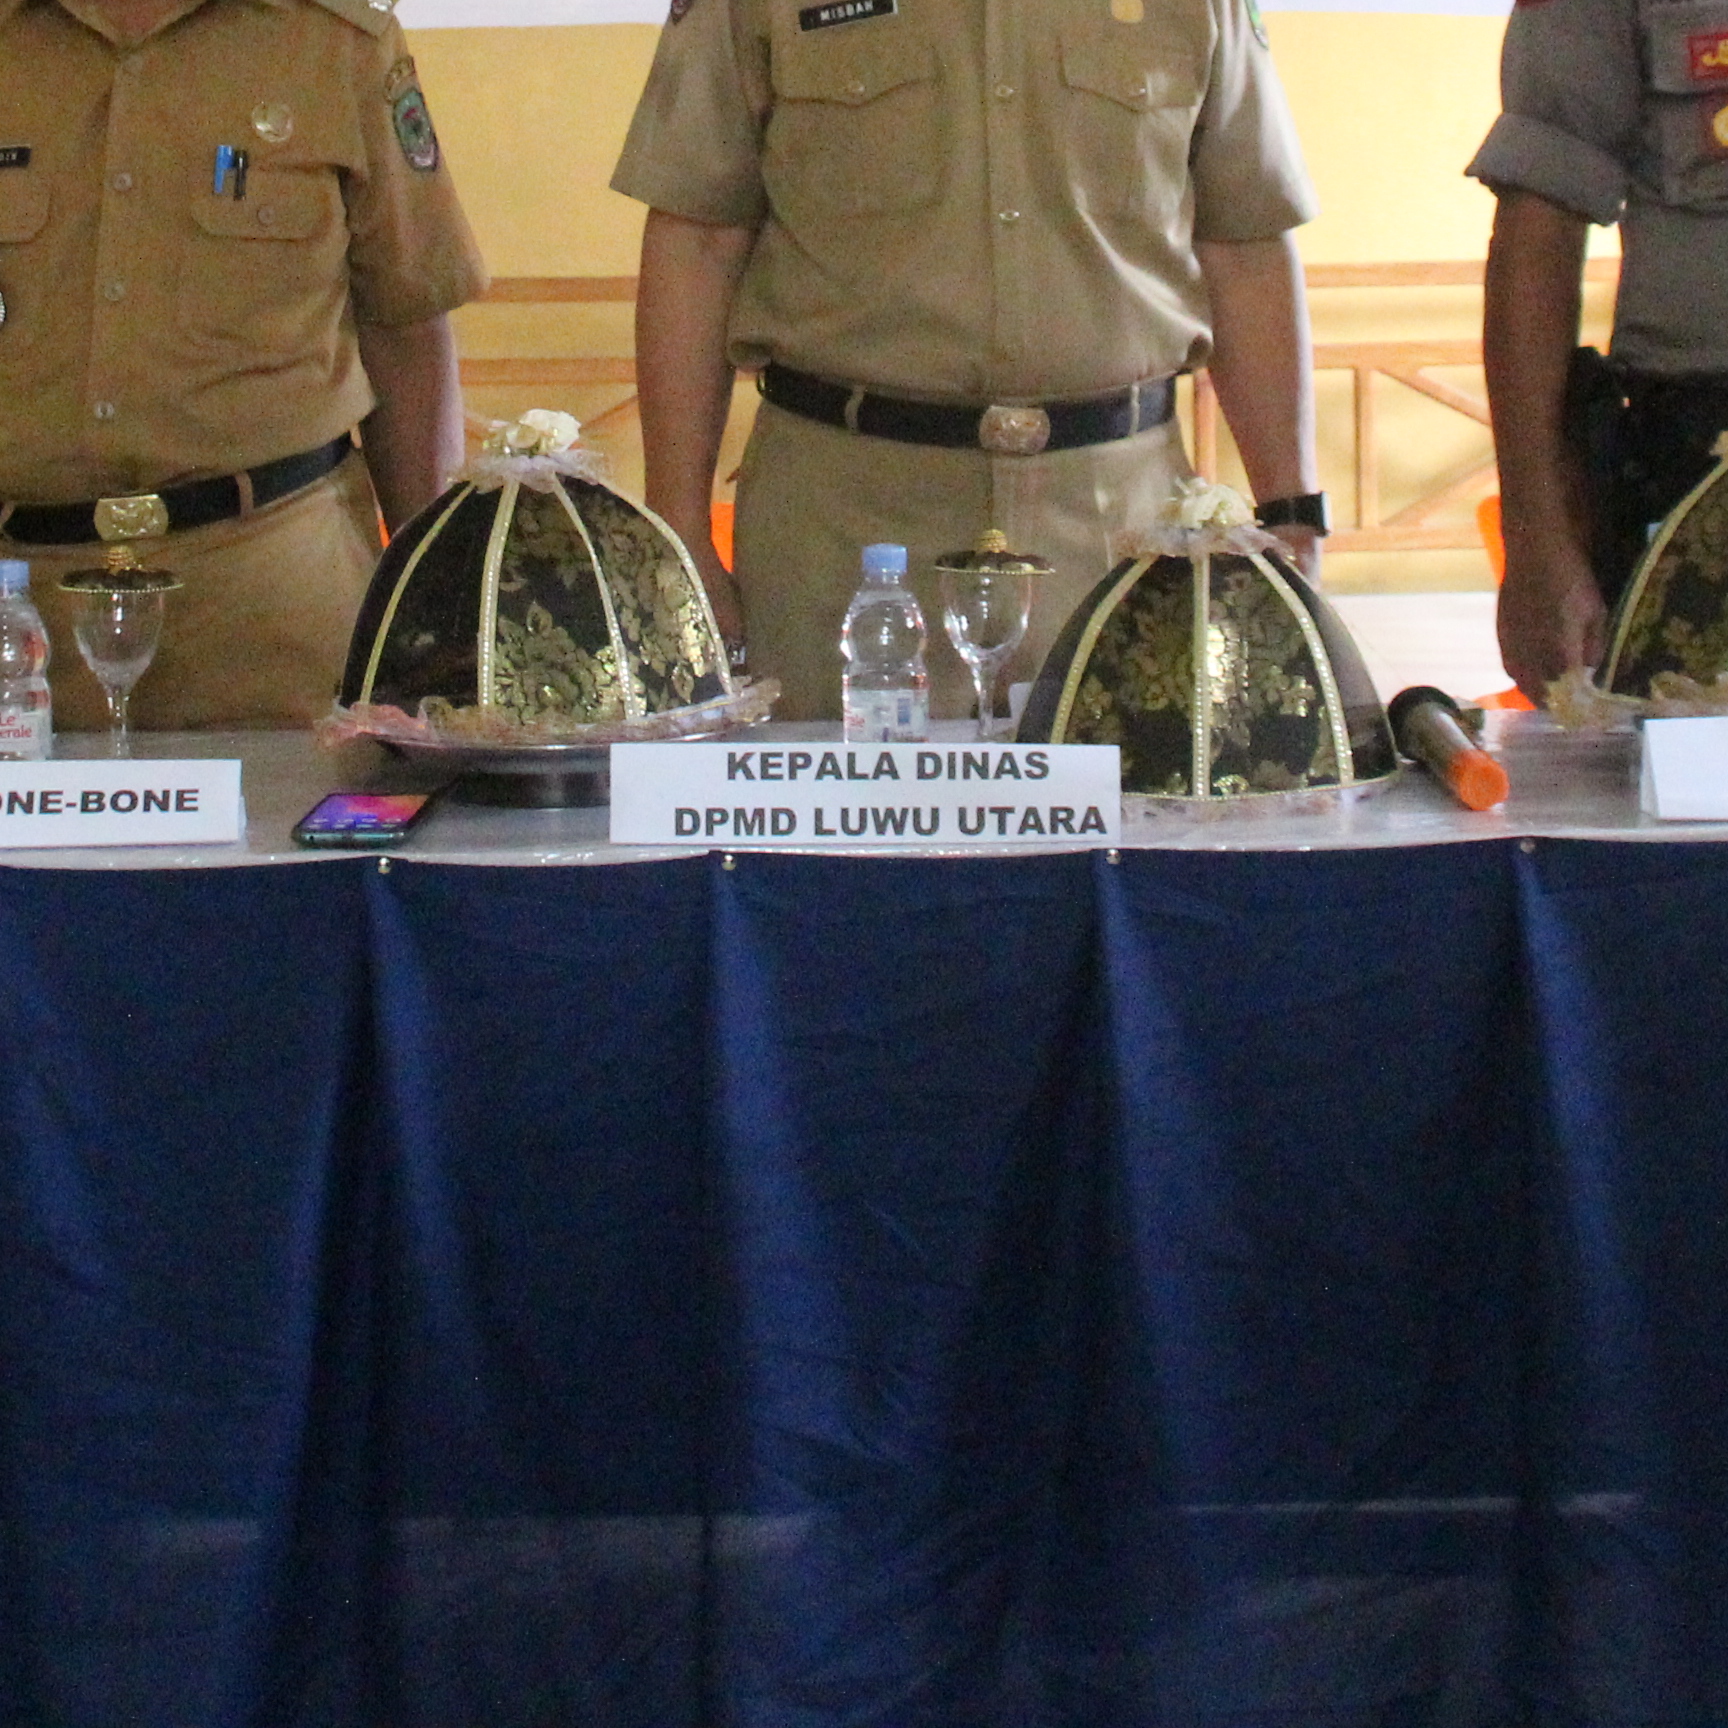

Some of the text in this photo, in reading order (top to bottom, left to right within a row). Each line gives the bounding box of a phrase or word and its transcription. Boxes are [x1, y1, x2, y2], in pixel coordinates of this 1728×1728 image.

[726, 750, 1051, 783] KEPALA DINAS
[673, 804, 1108, 837] DPMD LUWU UTARA
